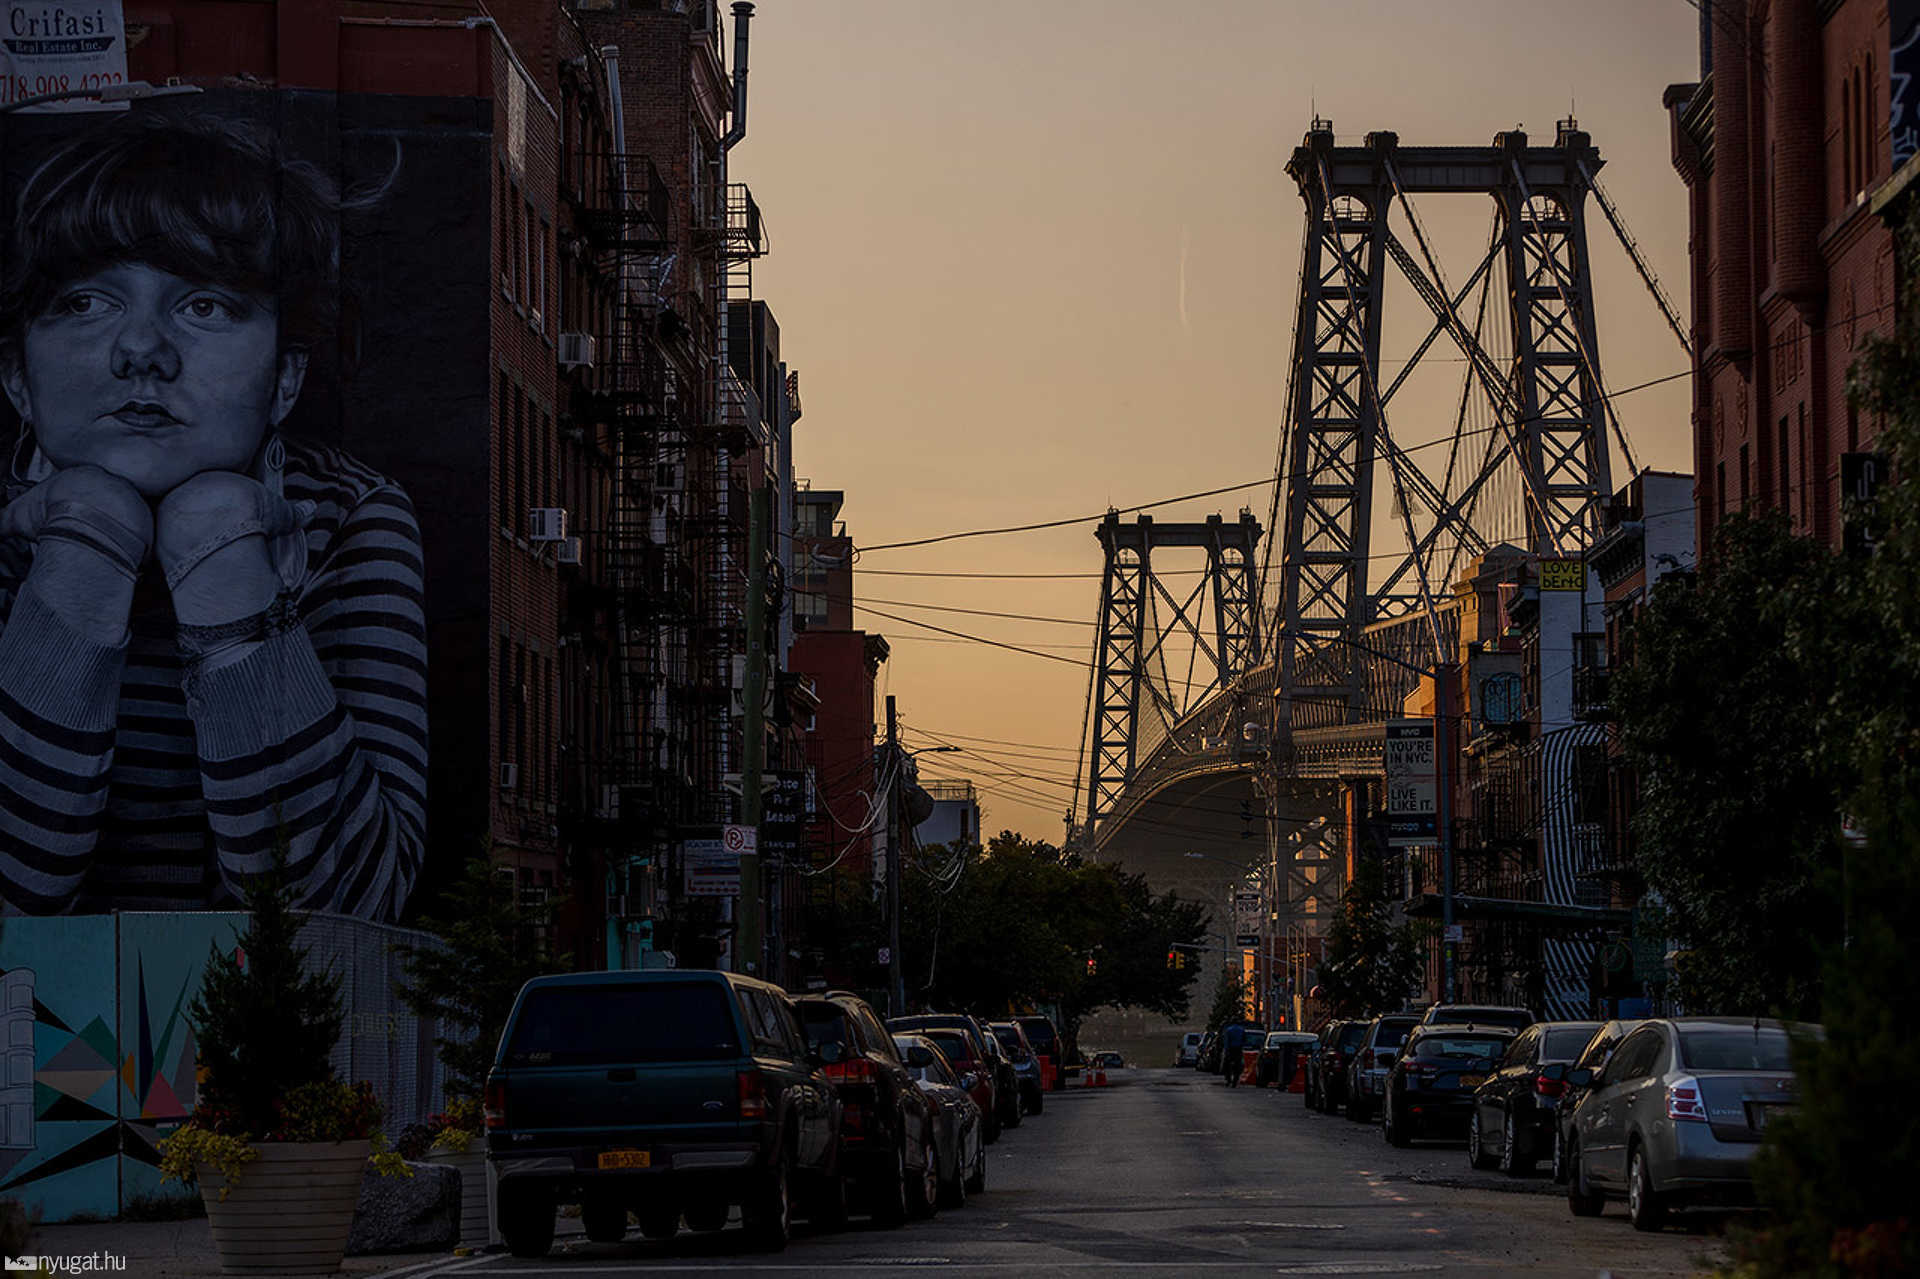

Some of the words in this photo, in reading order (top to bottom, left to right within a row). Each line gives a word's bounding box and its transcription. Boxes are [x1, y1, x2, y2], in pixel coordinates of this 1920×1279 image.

[11, 7, 104, 36] Crifasi
[15, 40, 39, 53] Real
[42, 40, 78, 53] Estate
[0, 72, 122, 103] 718-90842
[1543, 560, 1580, 574] LOVE
[1389, 741, 1432, 752] YOU'RE
[1390, 752, 1402, 763] IN
[1391, 789, 1417, 800] LIVE
[1391, 800, 1417, 811] LIKE
